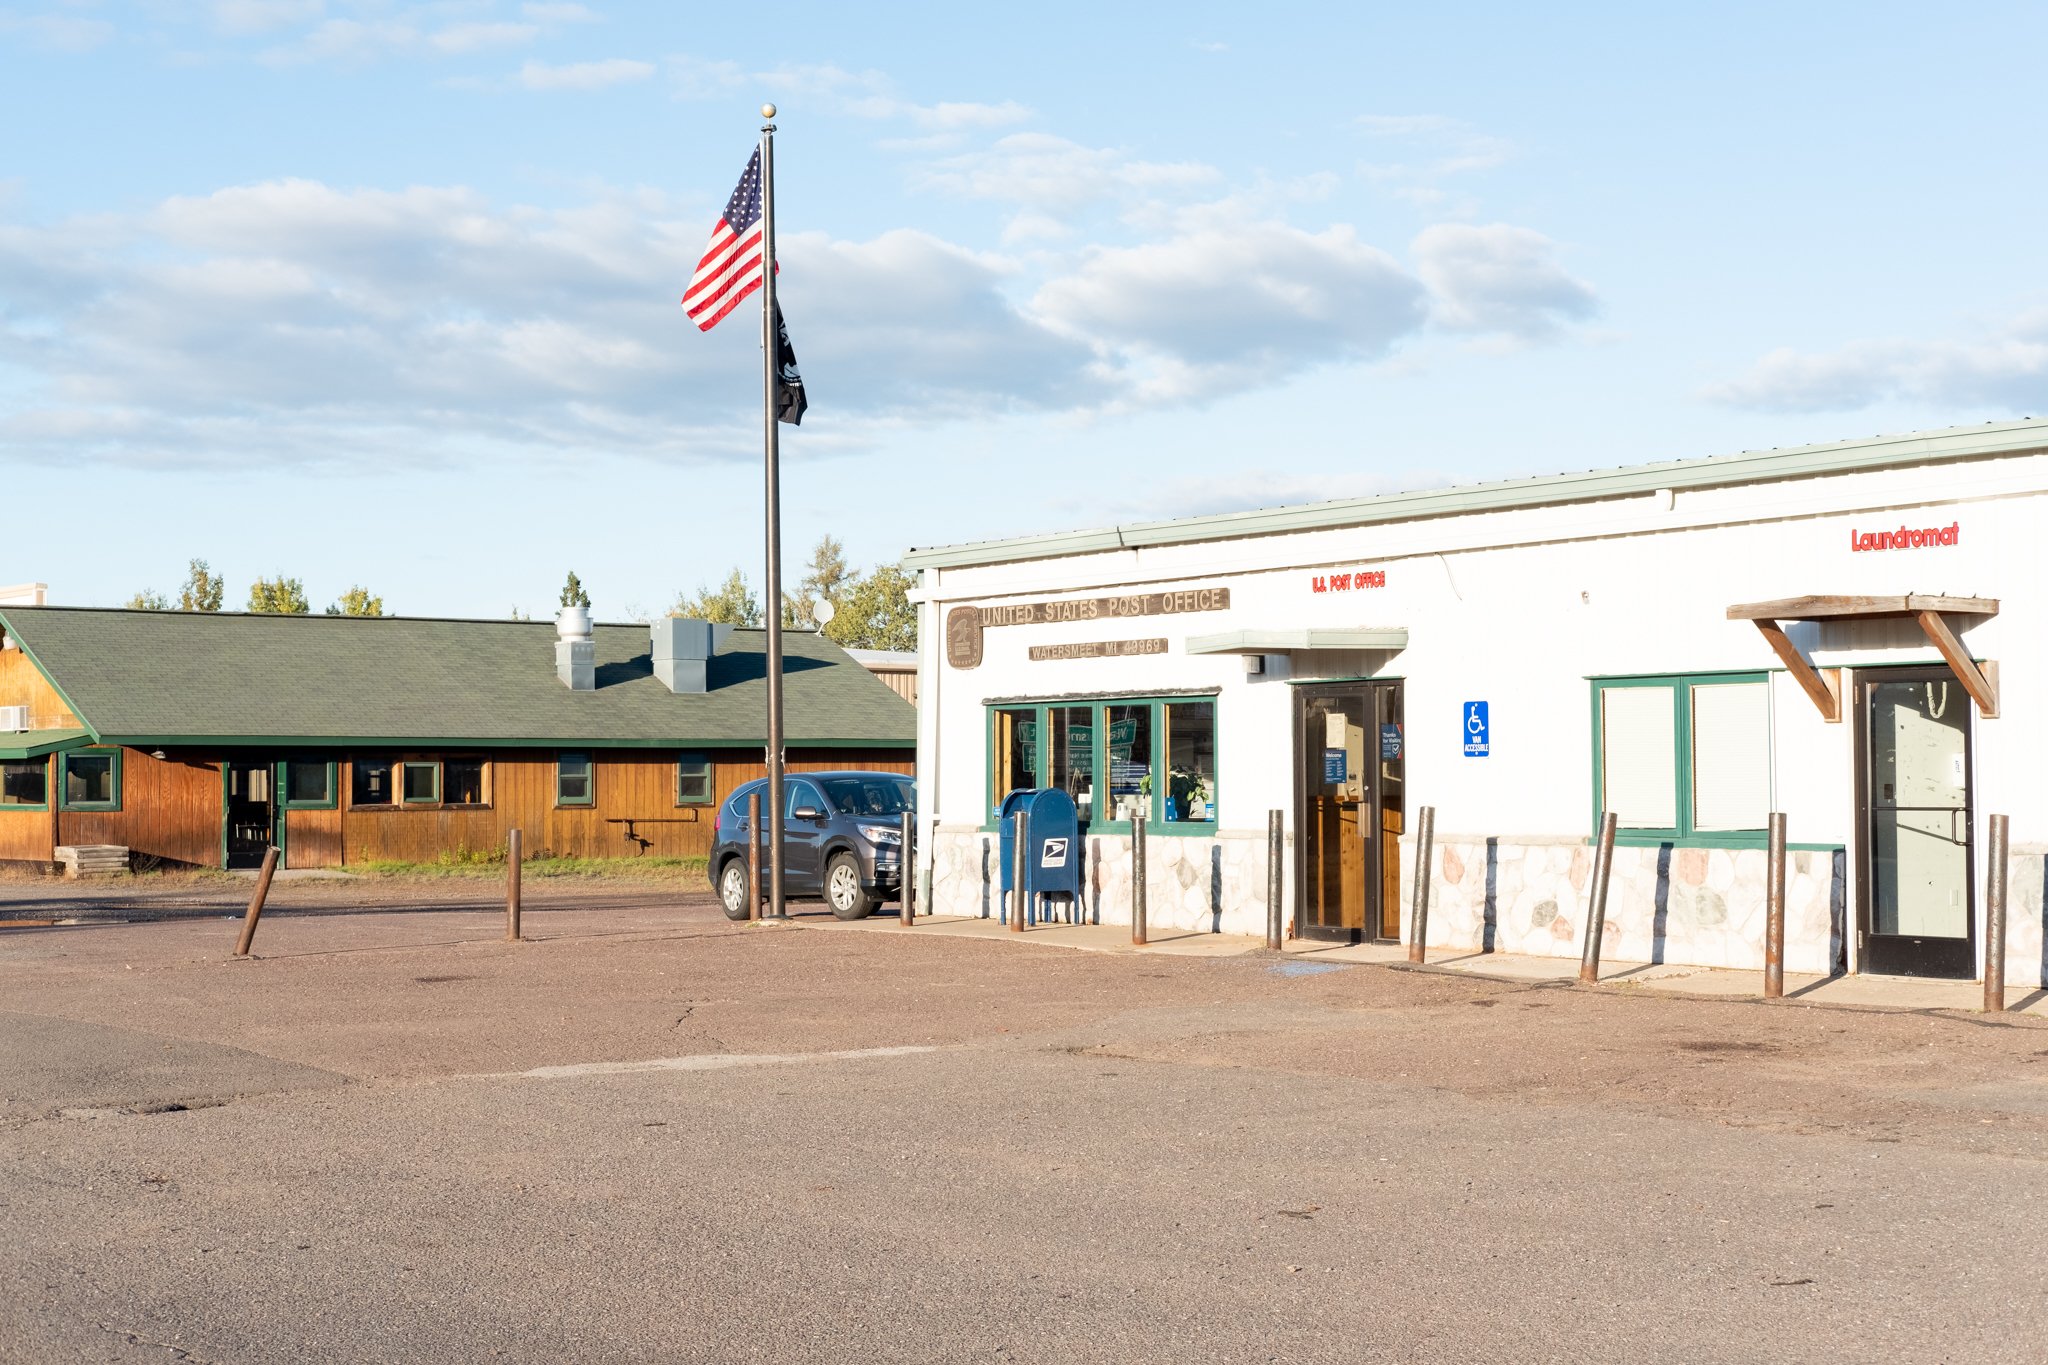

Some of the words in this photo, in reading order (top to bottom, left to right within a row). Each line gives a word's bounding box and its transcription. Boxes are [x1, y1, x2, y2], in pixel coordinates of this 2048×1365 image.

[1851, 521, 1960, 552] Laundromat
[1329, 573, 1352, 592] POST
[1354, 570, 1386, 590] OFFICE
[982, 604, 1034, 626] UNITED
[1045, 599, 1099, 621] STATES
[1108, 594, 1151, 617] POST
[1162, 588, 1222, 612] OFFICE
[1032, 642, 1099, 660] WATERSMEET
[1105, 641, 1118, 656] MI
[1124, 639, 1160, 655] 49969
